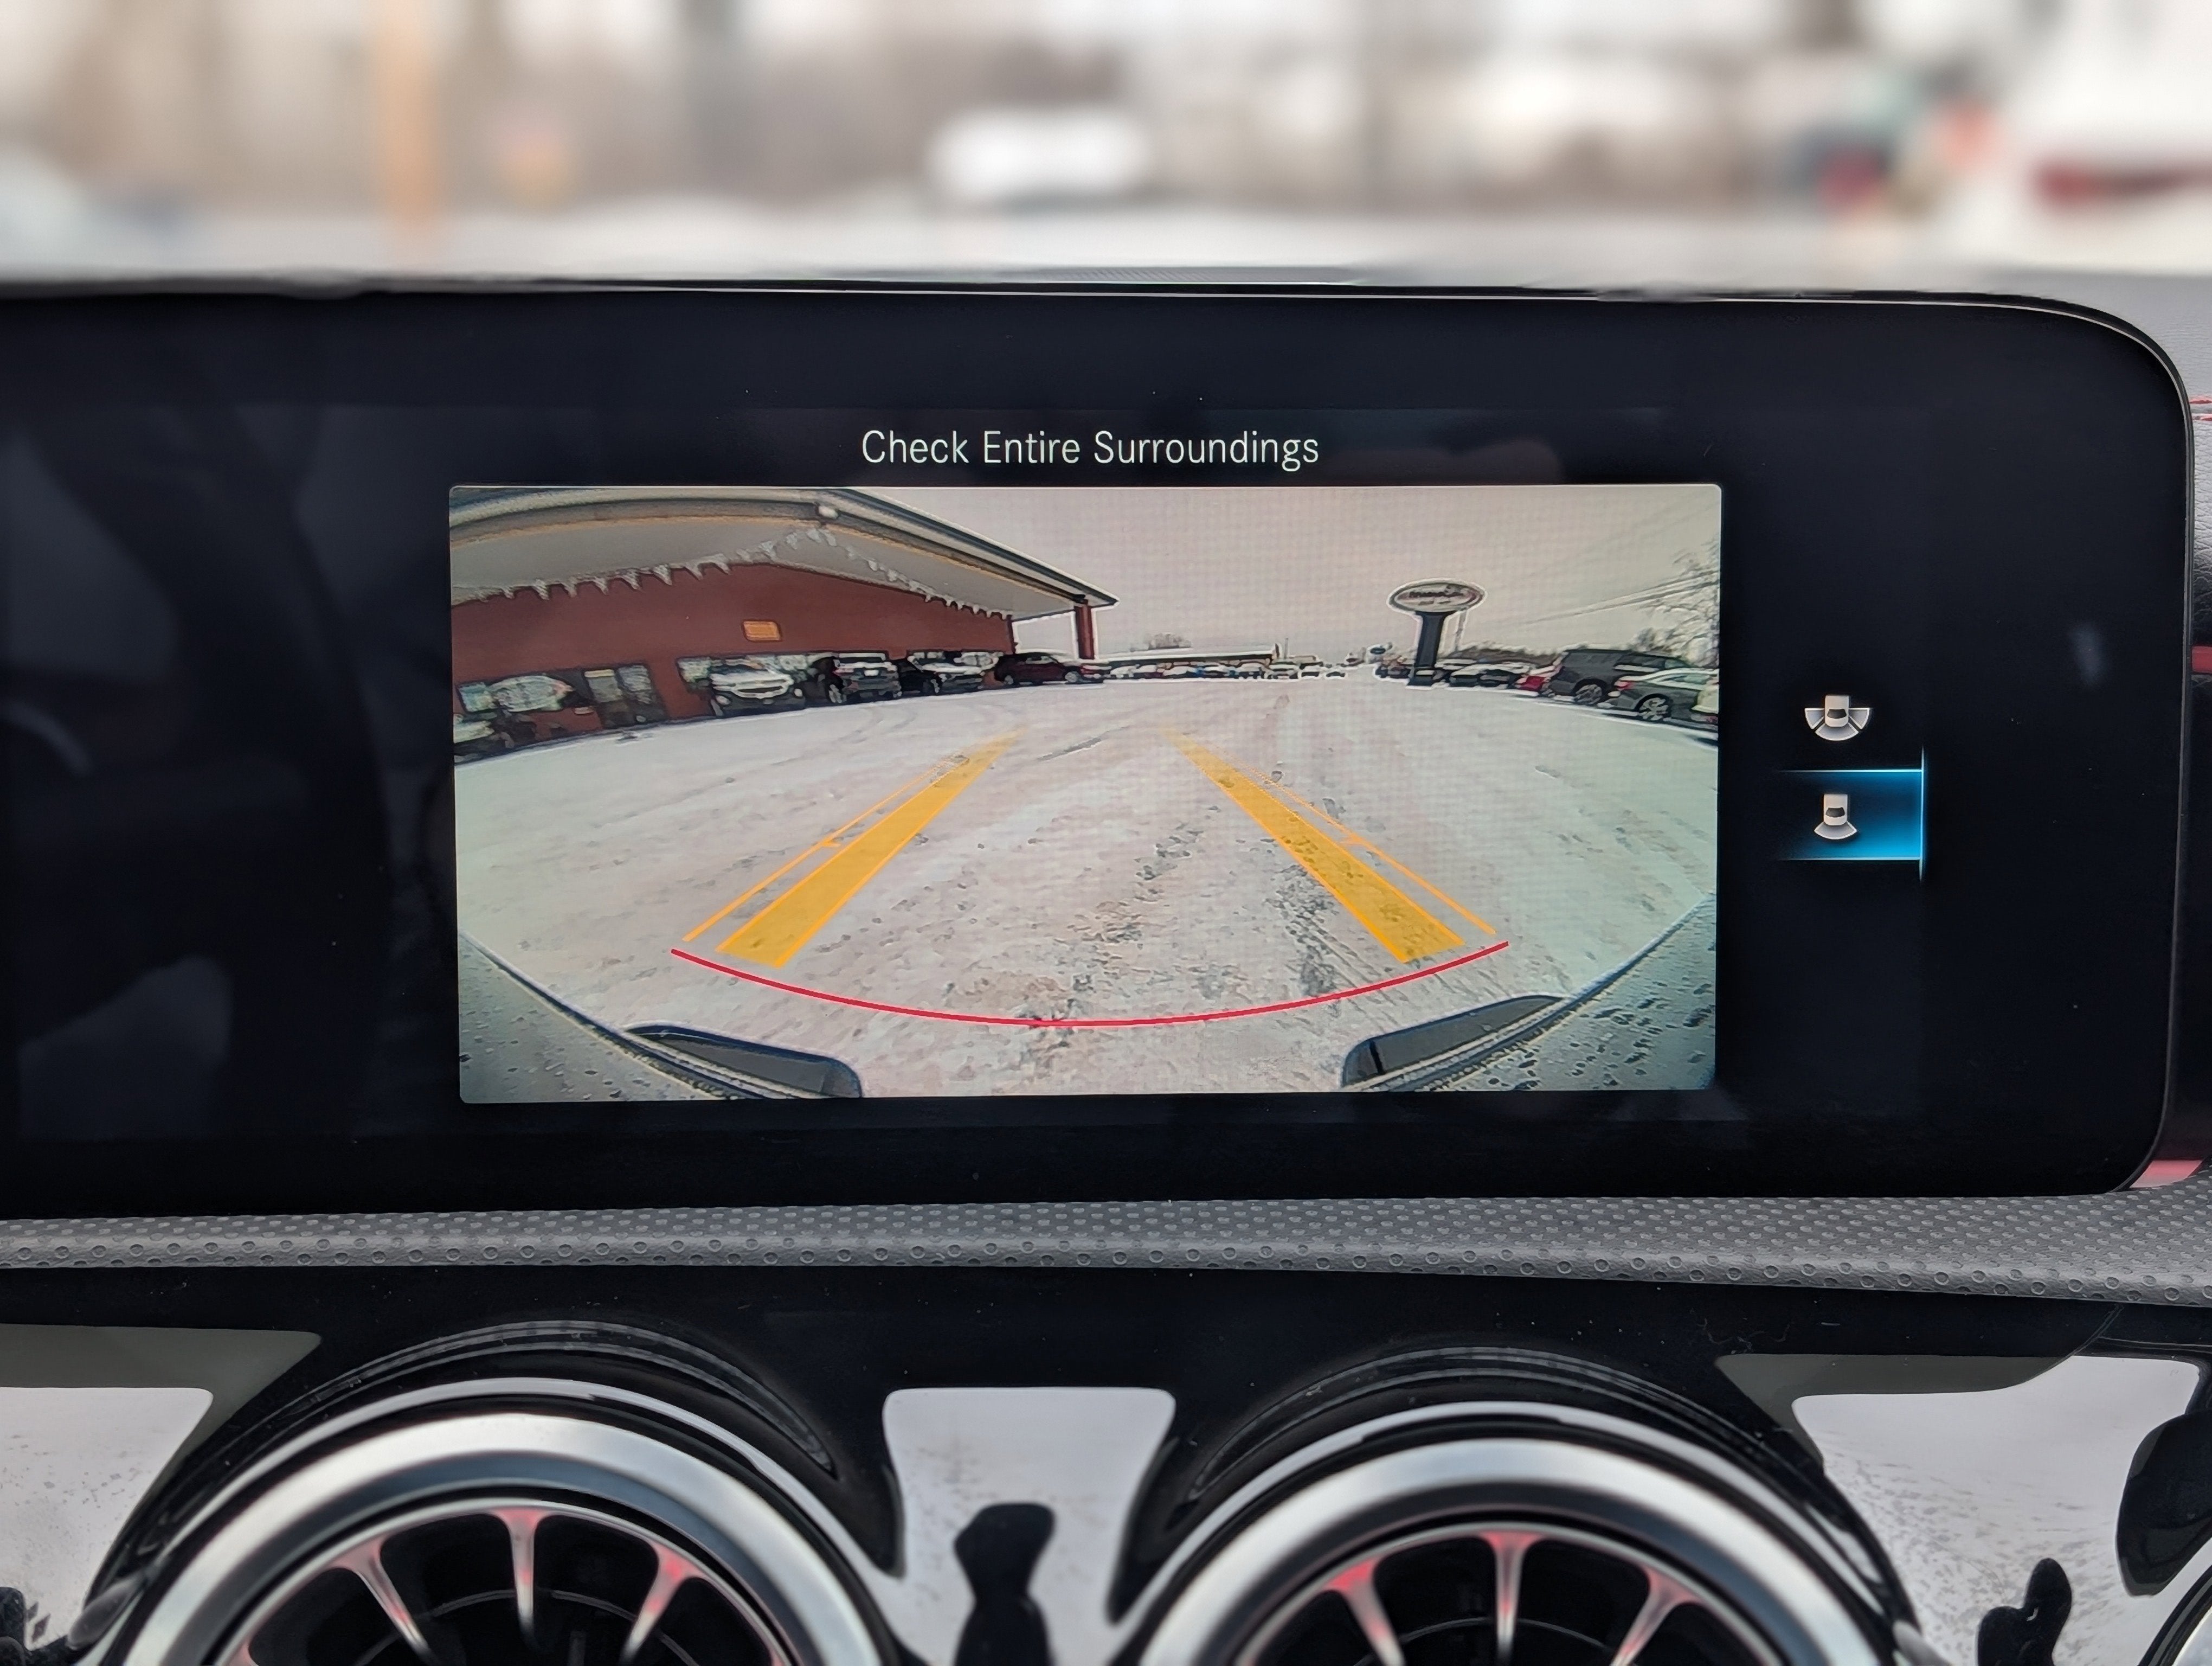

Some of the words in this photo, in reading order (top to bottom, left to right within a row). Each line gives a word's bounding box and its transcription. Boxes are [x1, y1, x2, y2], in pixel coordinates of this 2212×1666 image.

[861, 430, 969, 464] Check
[983, 430, 1081, 464] Entire
[1094, 430, 1319, 472] Surroundings
